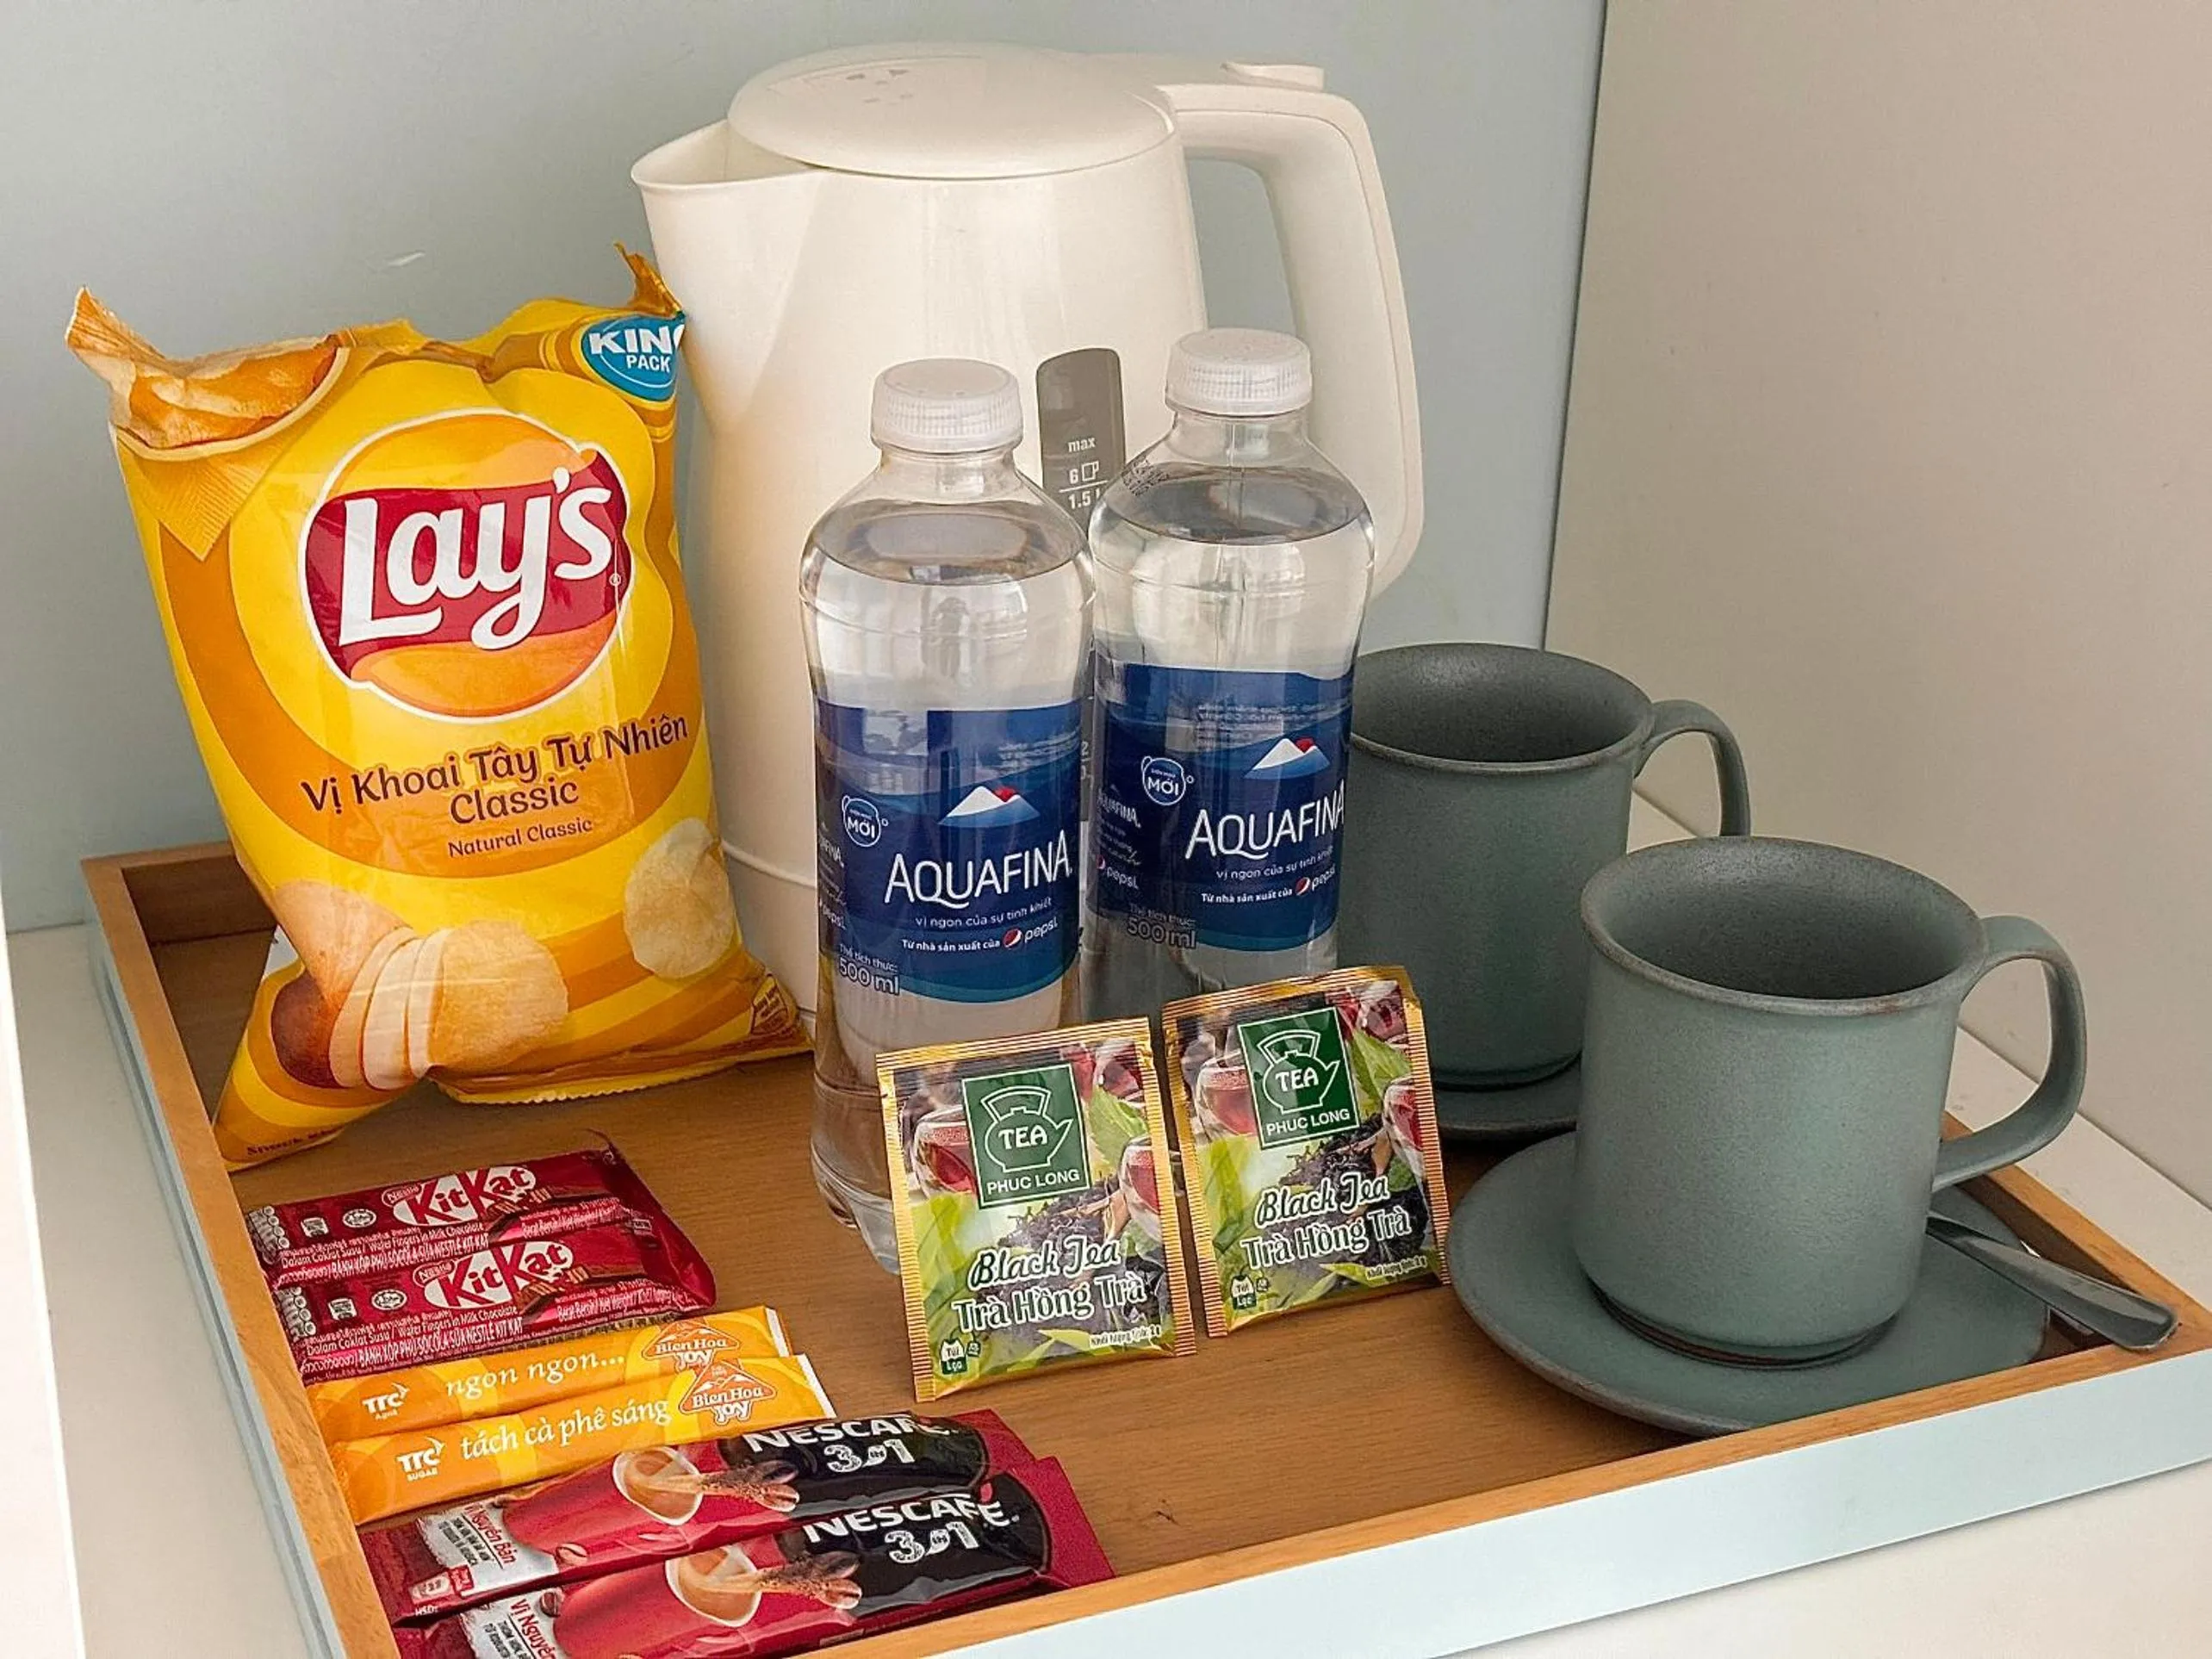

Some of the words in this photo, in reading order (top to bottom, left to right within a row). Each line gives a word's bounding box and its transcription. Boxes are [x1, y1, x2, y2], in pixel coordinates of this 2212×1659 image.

[626, 355, 671, 373] PACK
[1068, 438, 1096, 452] max
[1069, 469, 1079, 484] 6
[1069, 491, 1090, 509] 1.5
[339, 468, 612, 650] Lay's
[301, 777, 342, 815] Vị
[354, 755, 461, 804] Khoai
[469, 743, 538, 783] Tây
[546, 735, 593, 771] Tự
[602, 712, 688, 761] Nhiên
[1147, 776, 1179, 796] MỚI
[450, 777, 580, 824] Classic
[1185, 779, 1345, 860] AQUAFINA
[448, 829, 522, 858] Natural
[526, 817, 593, 842] Classic
[885, 830, 1071, 910] AQUAFINA
[1231, 868, 1261, 881] ngon
[1264, 863, 1283, 876] của
[1202, 892, 1214, 903] Từ
[1215, 894, 1235, 904] nhà
[1237, 892, 1254, 903] sản
[1256, 887, 1277, 901] xuất
[1278, 887, 1293, 898] của
[902, 939, 916, 949] Từ
[916, 940, 936, 952] nhà
[938, 941, 956, 952] sản
[958, 938, 981, 952] xuất
[983, 937, 1001, 949] của
[1024, 916, 1059, 943] pepsi
[930, 918, 962, 929] ngon
[966, 914, 987, 927] của
[1127, 916, 1165, 943] 500
[1169, 929, 1196, 949] ml
[840, 956, 871, 986] 500
[873, 974, 900, 996] ml
[1275, 1066, 1319, 1092] TEA
[1265, 1116, 1308, 1136] PHUC
[1310, 1108, 1351, 1127] LONG
[997, 1124, 1047, 1149] TEA
[986, 1176, 1032, 1195] PHUC
[1035, 1169, 1080, 1187] LONG
[1255, 1178, 1336, 1228] Black
[1340, 1171, 1389, 1213] Tea
[446, 1222, 484, 1238] Chocolate
[1240, 1233, 1295, 1270] Trà
[1294, 1216, 1370, 1260] Hồng
[1367, 1205, 1413, 1242] Trà
[969, 1240, 1059, 1289] Black
[1063, 1235, 1121, 1278] Tea
[952, 1296, 1011, 1333] Trà
[1012, 1282, 1095, 1324] Hồng
[1094, 1271, 1147, 1308] Trà
[338, 1335, 368, 1351] Coklat
[369, 1333, 390, 1345] Susu
[461, 1310, 478, 1324] Milk
[479, 1305, 519, 1320] Chocolate
[509, 1315, 524, 1335] KAT
[446, 1368, 519, 1400] ngon
[527, 1352, 624, 1384] ngon...
[362, 1392, 404, 1414] TTC
[460, 1426, 519, 1461] tách
[525, 1423, 554, 1447] cà
[560, 1407, 606, 1447] phê
[612, 1399, 672, 1427] sáng
[397, 1447, 441, 1473] TTC
[407, 1467, 438, 1482] SUGAR
[494, 1540, 518, 1565] Bản
[510, 1598, 531, 1617] Vị
